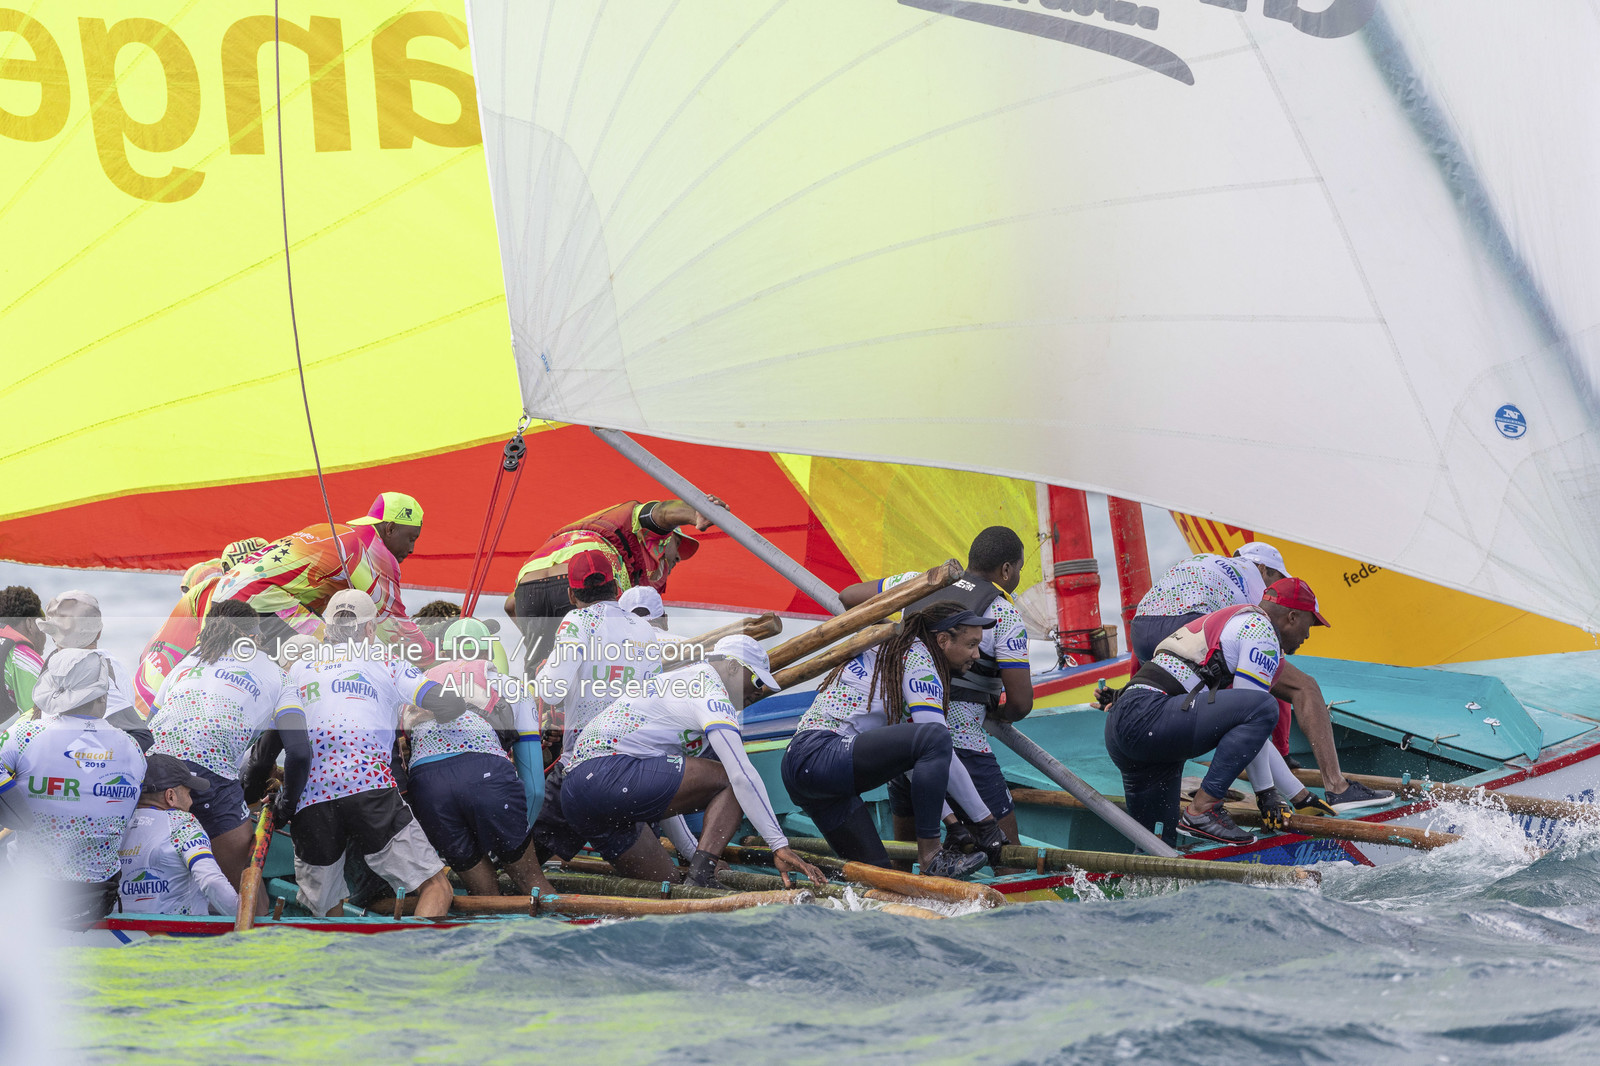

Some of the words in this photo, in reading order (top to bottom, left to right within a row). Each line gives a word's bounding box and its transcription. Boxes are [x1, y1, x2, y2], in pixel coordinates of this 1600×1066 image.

[592, 665, 636, 684] UFR
[214, 668, 261, 702] CHANFLOR
[331, 679, 379, 702] CHANFLOR
[85, 761, 106, 769] 2019
[28, 775, 80, 797] UFR
[93, 783, 138, 800] CHANFLOR
[122, 880, 170, 895] CHANFLOR
